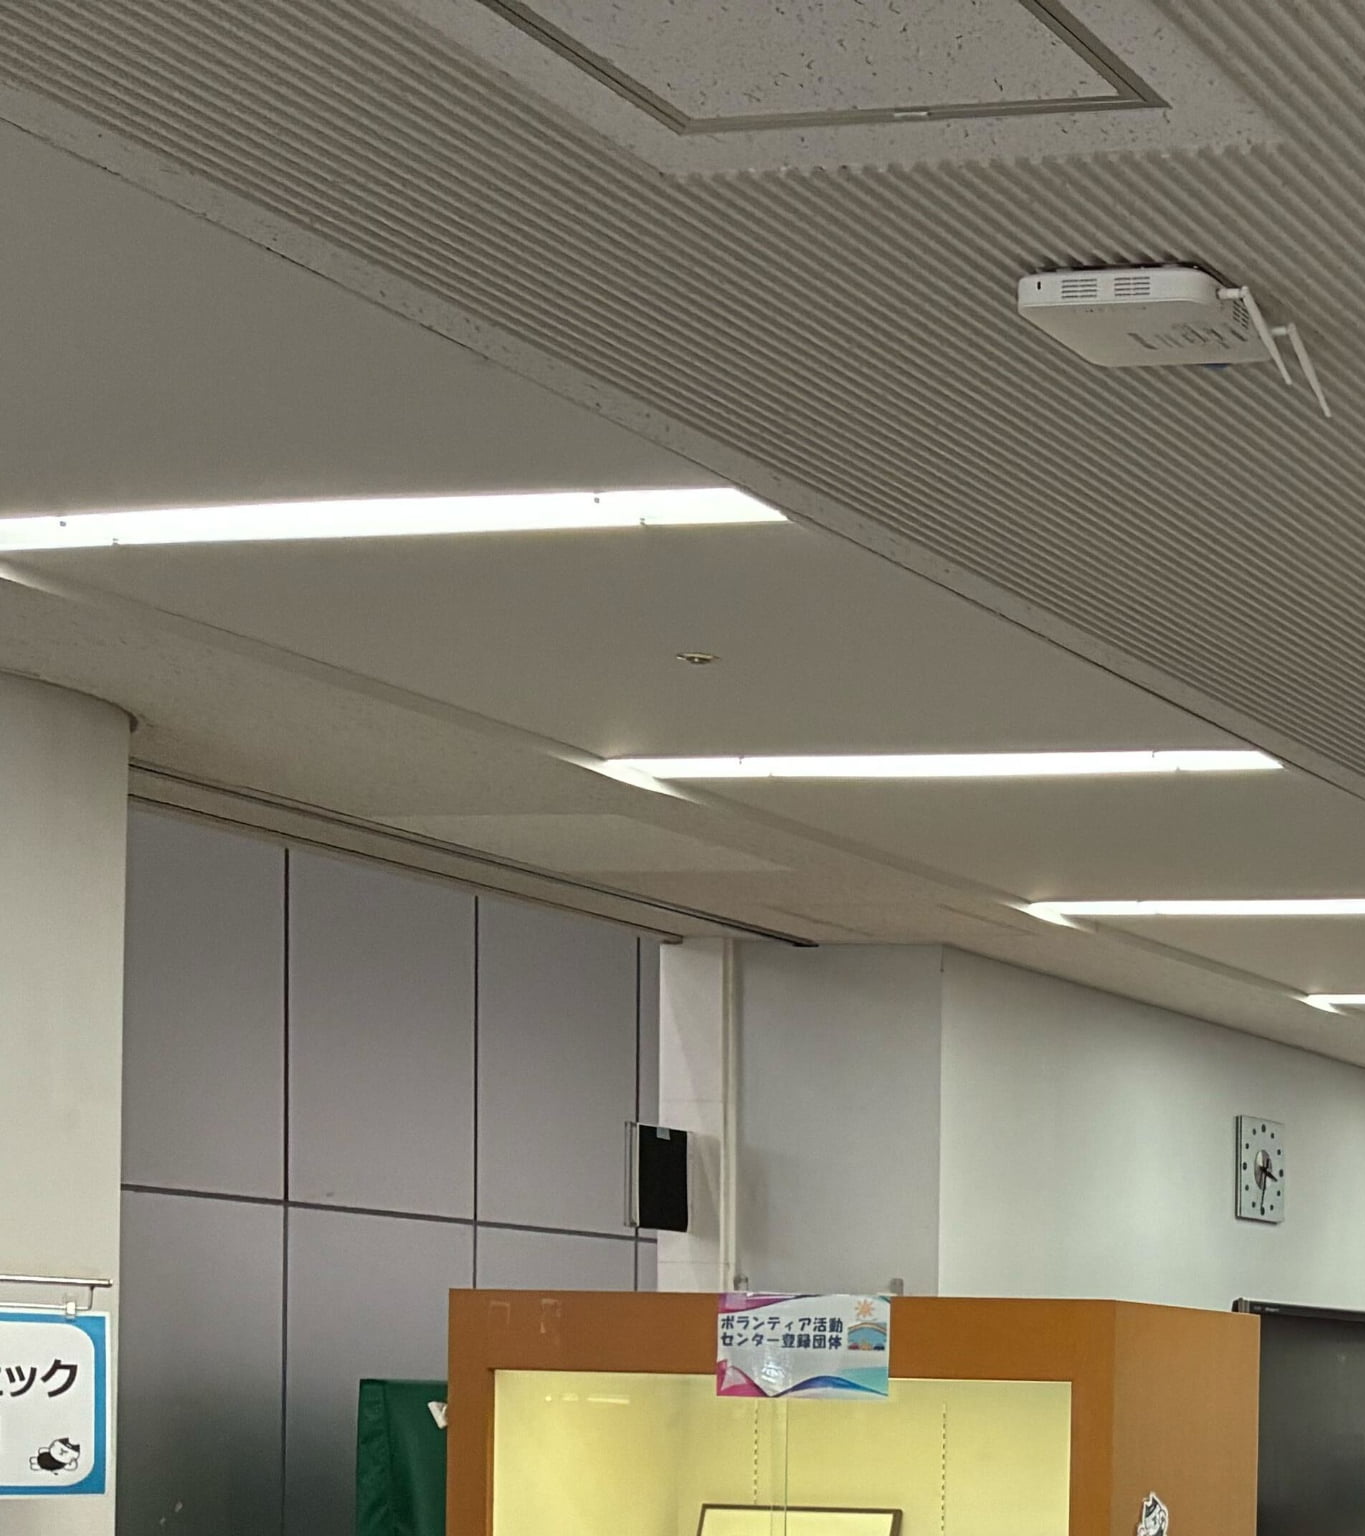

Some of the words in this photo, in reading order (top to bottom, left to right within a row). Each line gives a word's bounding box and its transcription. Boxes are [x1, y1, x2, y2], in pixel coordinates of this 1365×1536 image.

[721, 1315, 843, 1333] ボランティア活動
[721, 1333, 843, 1349] センター登録団体
[0, 1359, 78, 1397] ック
